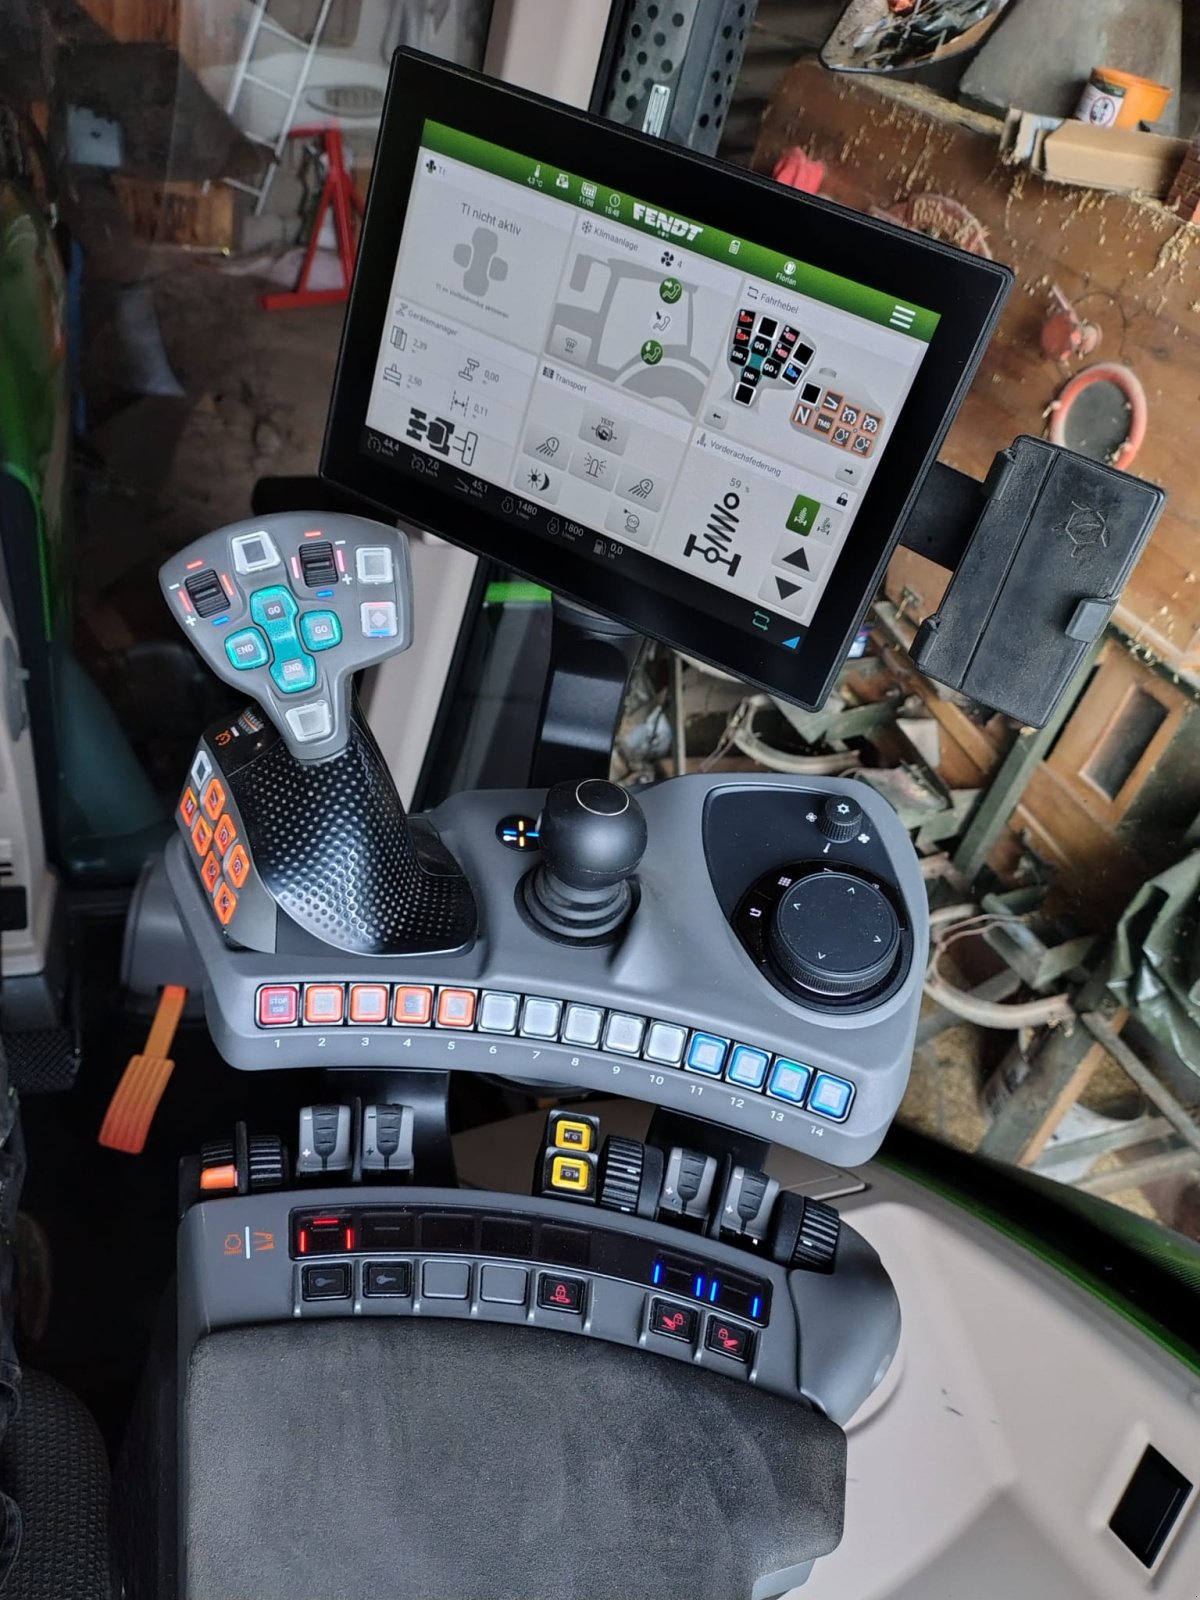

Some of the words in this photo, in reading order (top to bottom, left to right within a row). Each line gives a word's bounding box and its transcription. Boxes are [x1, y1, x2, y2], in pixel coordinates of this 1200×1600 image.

[472, 206, 496, 224] nicht
[498, 216, 522, 236] aktiv
[632, 201, 704, 242] FENDT
[594, 226, 639, 252] Klimaanlage
[677, 260, 683, 269] 4
[775, 272, 797, 286] Florian
[760, 293, 799, 314] Fahrhebel
[407, 309, 458, 336] Gerätemanager
[754, 341, 765, 350] GO
[763, 363, 774, 372] GO
[555, 373, 587, 393] Transport
[600, 417, 615, 428] TEST
[794, 406, 810, 425] N
[710, 440, 782, 477] Vorderachsfederung
[472, 479, 488, 493] 45,1
[729, 477, 742, 489] 59
[518, 500, 538, 516] 1480
[564, 521, 584, 537] 1800
[610, 543, 623, 555] 0,0
[268, 605, 281, 615] GO
[314, 625, 328, 635] GO
[236, 644, 254, 655] END
[283, 662, 301, 673] END
[274, 1039, 281, 1049] 1
[318, 1037, 326, 1047] 2
[361, 1036, 370, 1047] 3
[403, 1037, 412, 1048] 4
[447, 1041, 456, 1051] 5
[489, 1045, 498, 1055] 6
[532, 1050, 541, 1060] 7
[570, 1057, 580, 1067] 8
[612, 1065, 621, 1075] 9
[649, 1074, 665, 1086] 10
[689, 1084, 705, 1096] 11
[730, 1096, 745, 1109] 12
[770, 1110, 785, 1123] 13
[810, 1125, 824, 1138] 14
